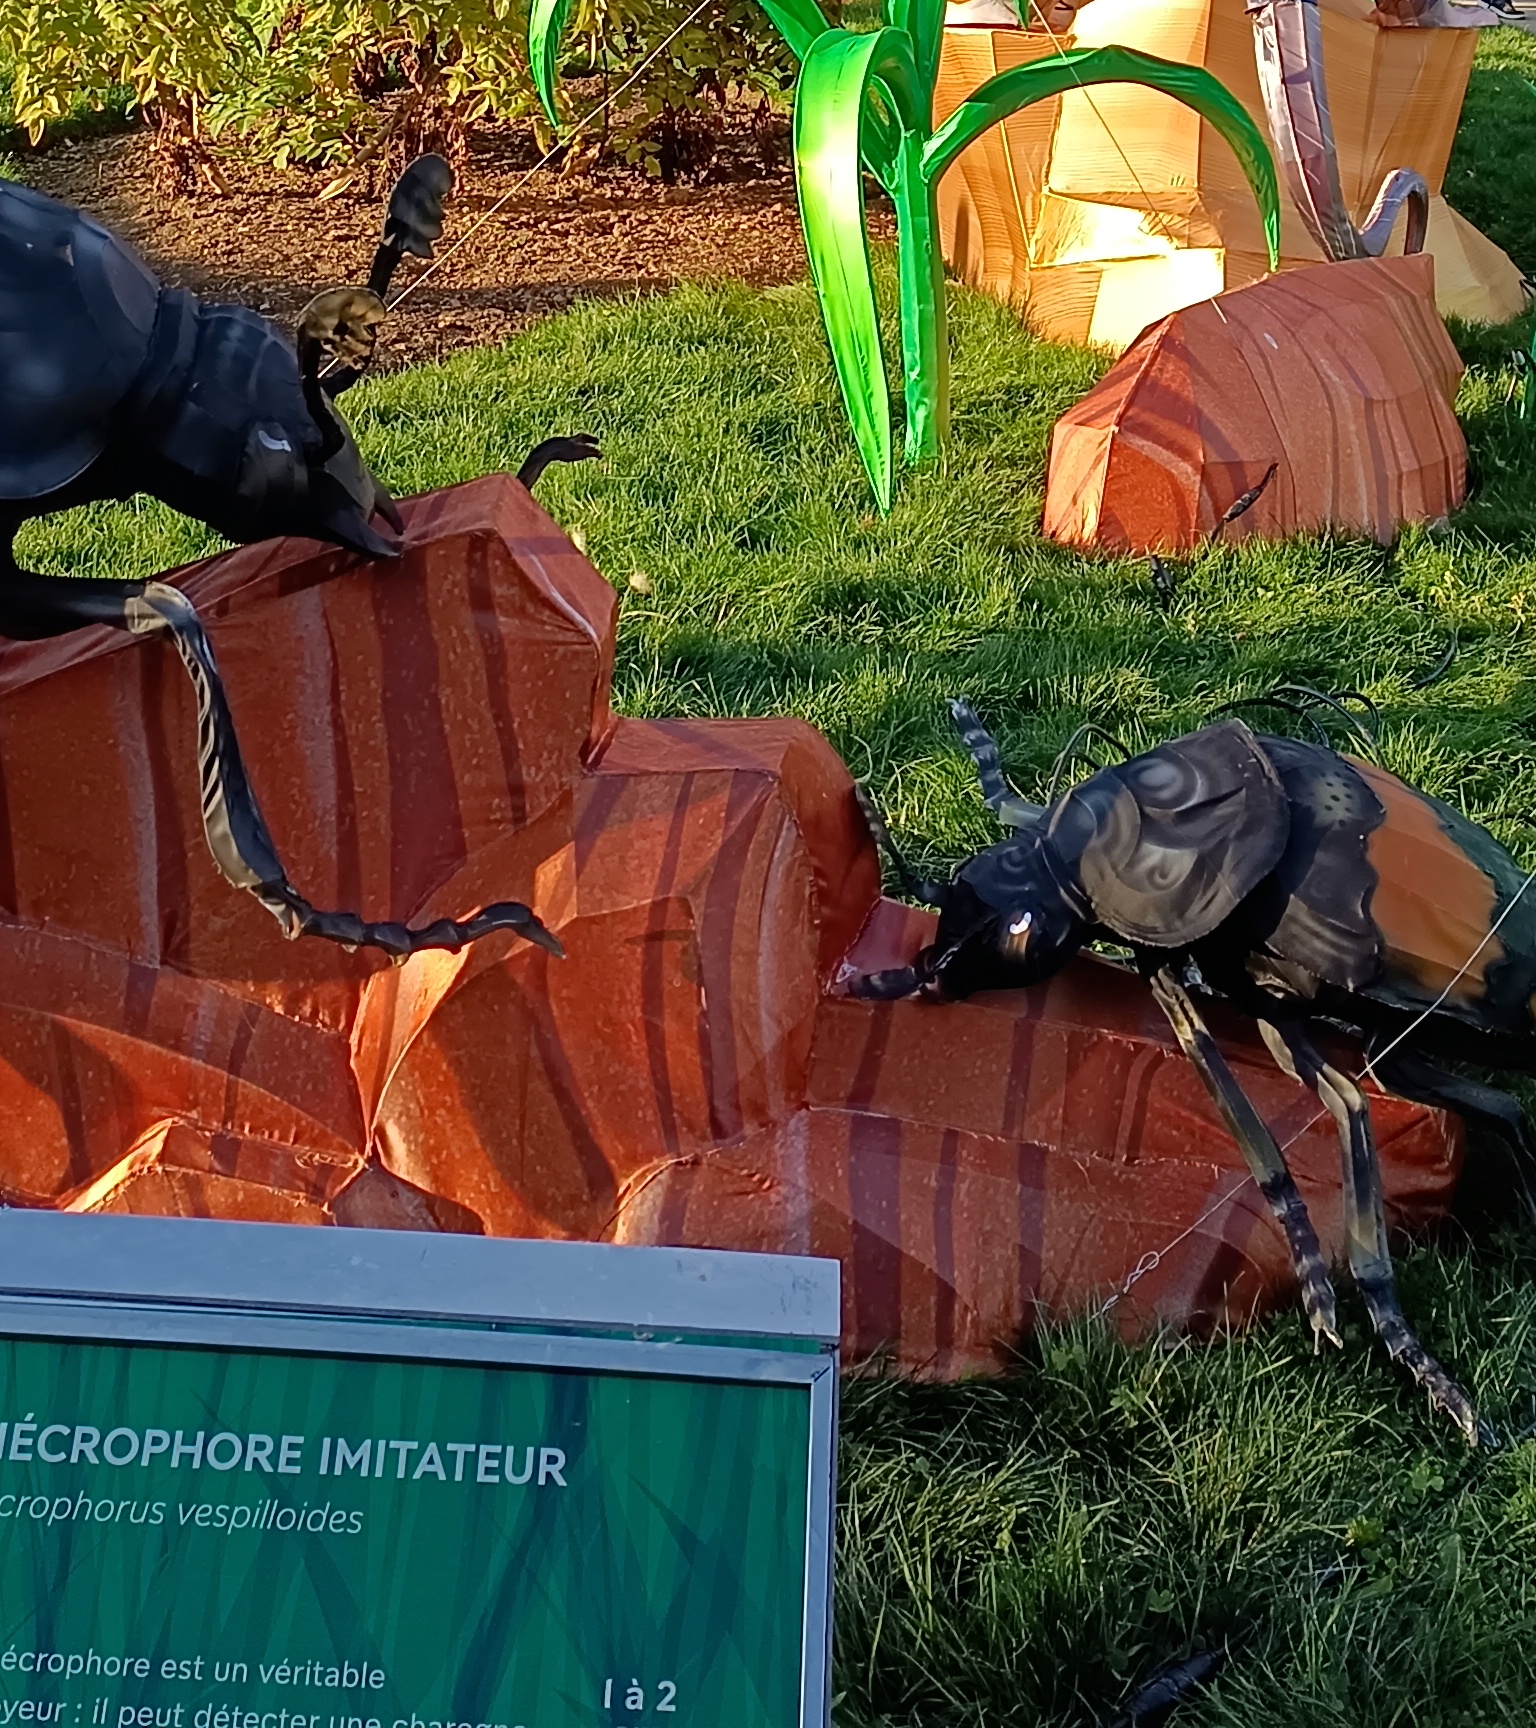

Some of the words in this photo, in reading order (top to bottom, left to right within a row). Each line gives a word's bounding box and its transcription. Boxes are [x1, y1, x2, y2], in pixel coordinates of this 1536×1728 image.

[319, 1438, 567, 1486] IMITATEUR
[179, 1499, 363, 1534] vespilloides
[161, 1656, 204, 1680] est
[215, 1662, 247, 1682] un
[259, 1658, 385, 1689] véritable
[626, 1678, 643, 1710] à
[657, 1681, 676, 1711] 2
[93, 1698, 108, 1724] il
[118, 1703, 184, 1728] peut
[194, 1703, 320, 1728] détecter
